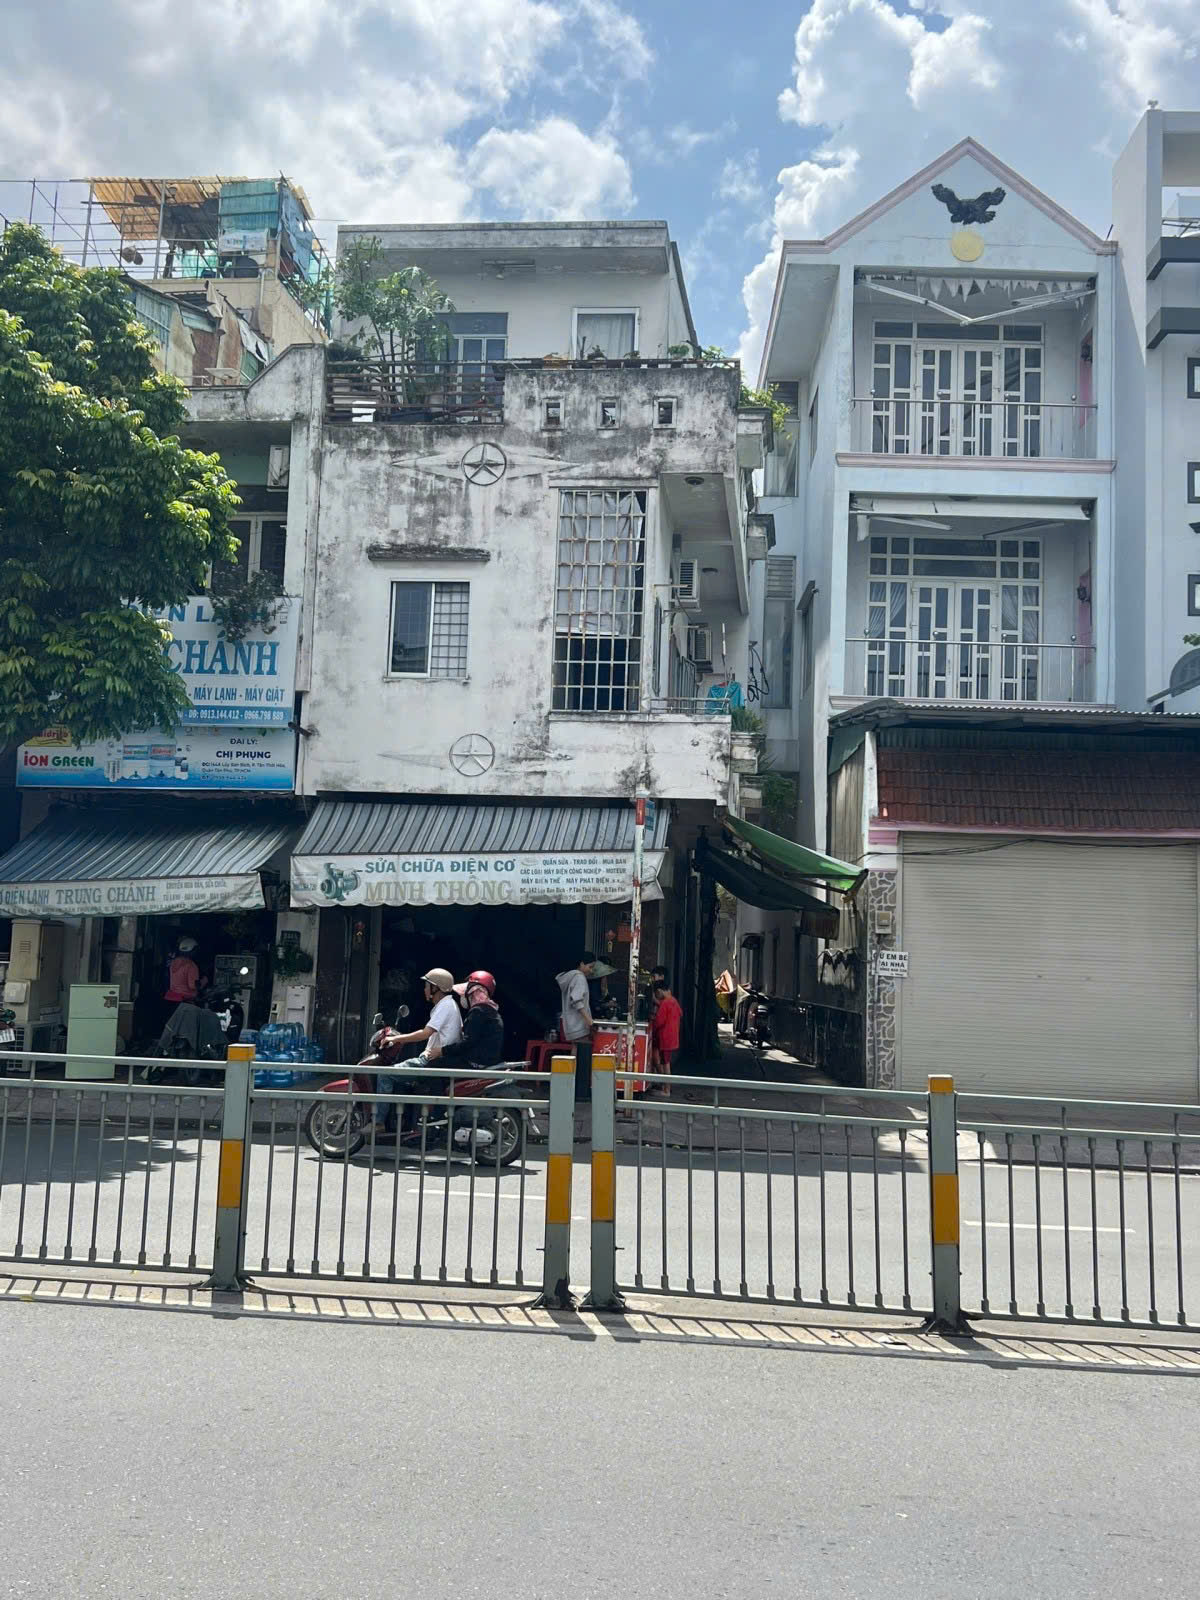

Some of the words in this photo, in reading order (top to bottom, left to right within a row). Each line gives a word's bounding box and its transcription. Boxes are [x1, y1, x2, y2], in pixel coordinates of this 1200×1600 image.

[194, 683, 213, 701] MÁY
[215, 687, 238, 704] LẠNH
[245, 684, 265, 702] MÁY
[52, 756, 95, 767] GREEN
[216, 751, 233, 761] CHỊ
[235, 751, 272, 761] PHỤNG
[364, 857, 396, 873] SỬA
[401, 858, 445, 873] CHỮA
[450, 857, 489, 874] ĐIỆN
[494, 858, 516, 872] CƠ
[56, 886, 102, 905] TRUNG
[107, 882, 156, 903] CHÁNH
[365, 881, 424, 902] MINH
[432, 876, 513, 903] THÔNG
[886, 953, 897, 961] EM
